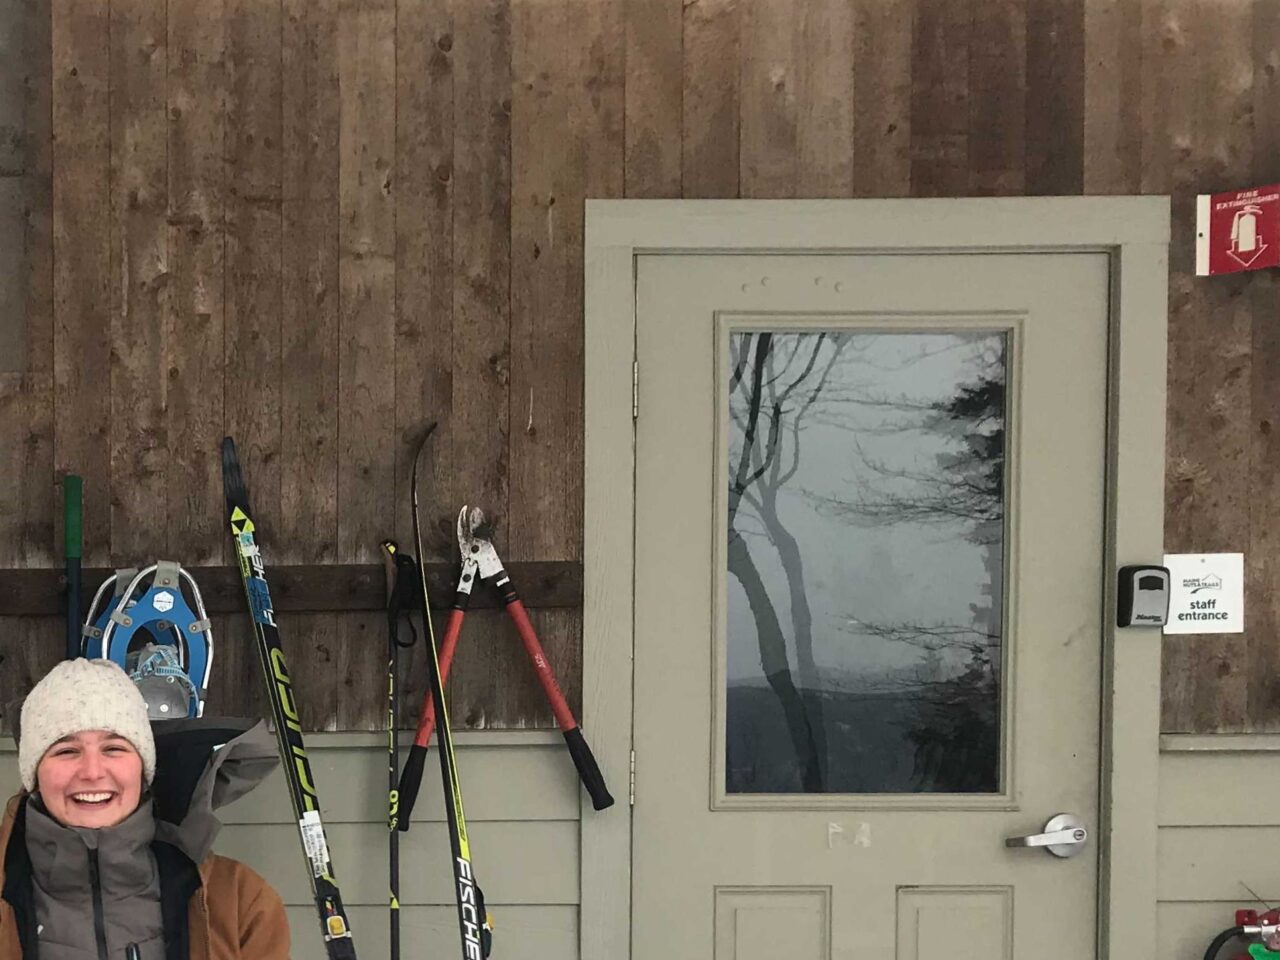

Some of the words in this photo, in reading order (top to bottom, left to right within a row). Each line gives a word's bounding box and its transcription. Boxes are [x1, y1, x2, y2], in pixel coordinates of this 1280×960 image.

[1236, 190, 1259, 200] FIRE
[1190, 599, 1216, 609] staff
[1178, 612, 1228, 621] entrance
